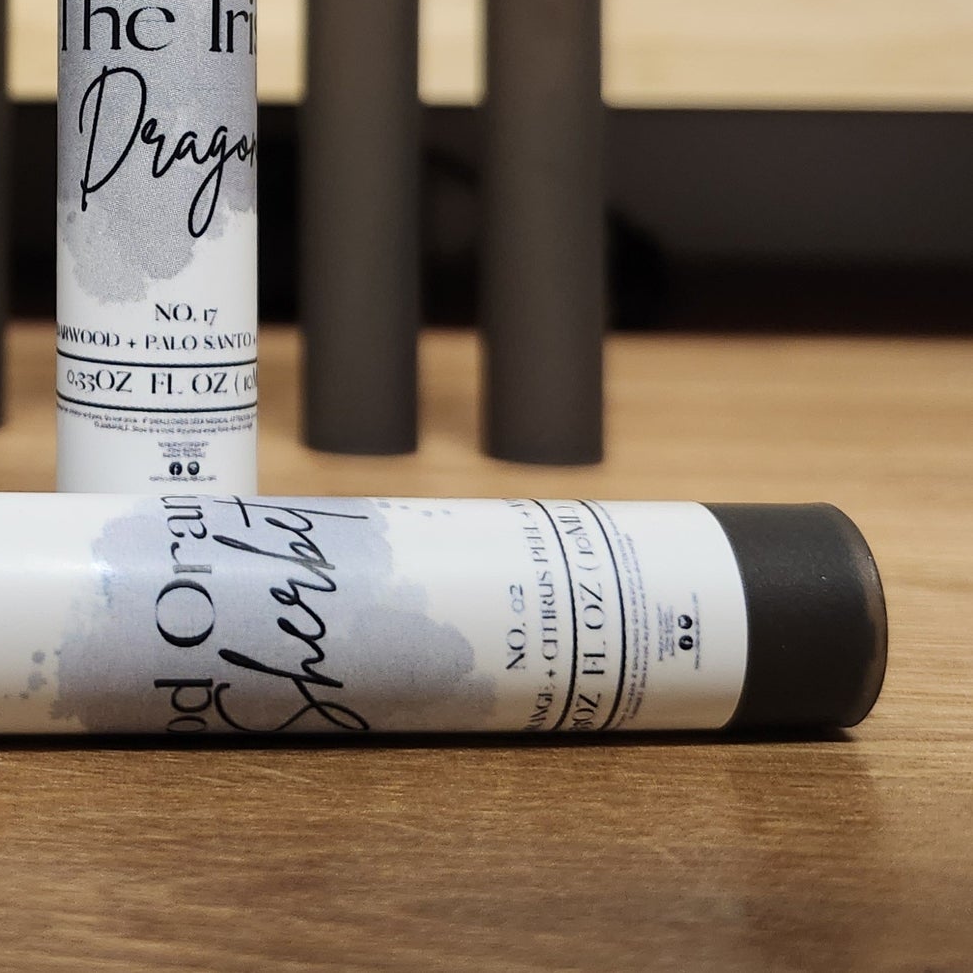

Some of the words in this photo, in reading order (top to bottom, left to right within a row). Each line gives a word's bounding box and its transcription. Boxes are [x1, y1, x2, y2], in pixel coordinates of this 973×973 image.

[155, 302, 197, 323] NO.
[203, 307, 218, 326] 17
[145, 333, 198, 351] PALO
[203, 330, 251, 350] SANTO
[66, 368, 133, 394] 0.33OZ
[191, 371, 228, 394] OZ
[523, 521, 549, 563] PEEL
[508, 583, 525, 614] 02
[538, 570, 559, 661] CITRUS
[578, 581, 605, 631] OZ
[504, 620, 527, 671] NO.
